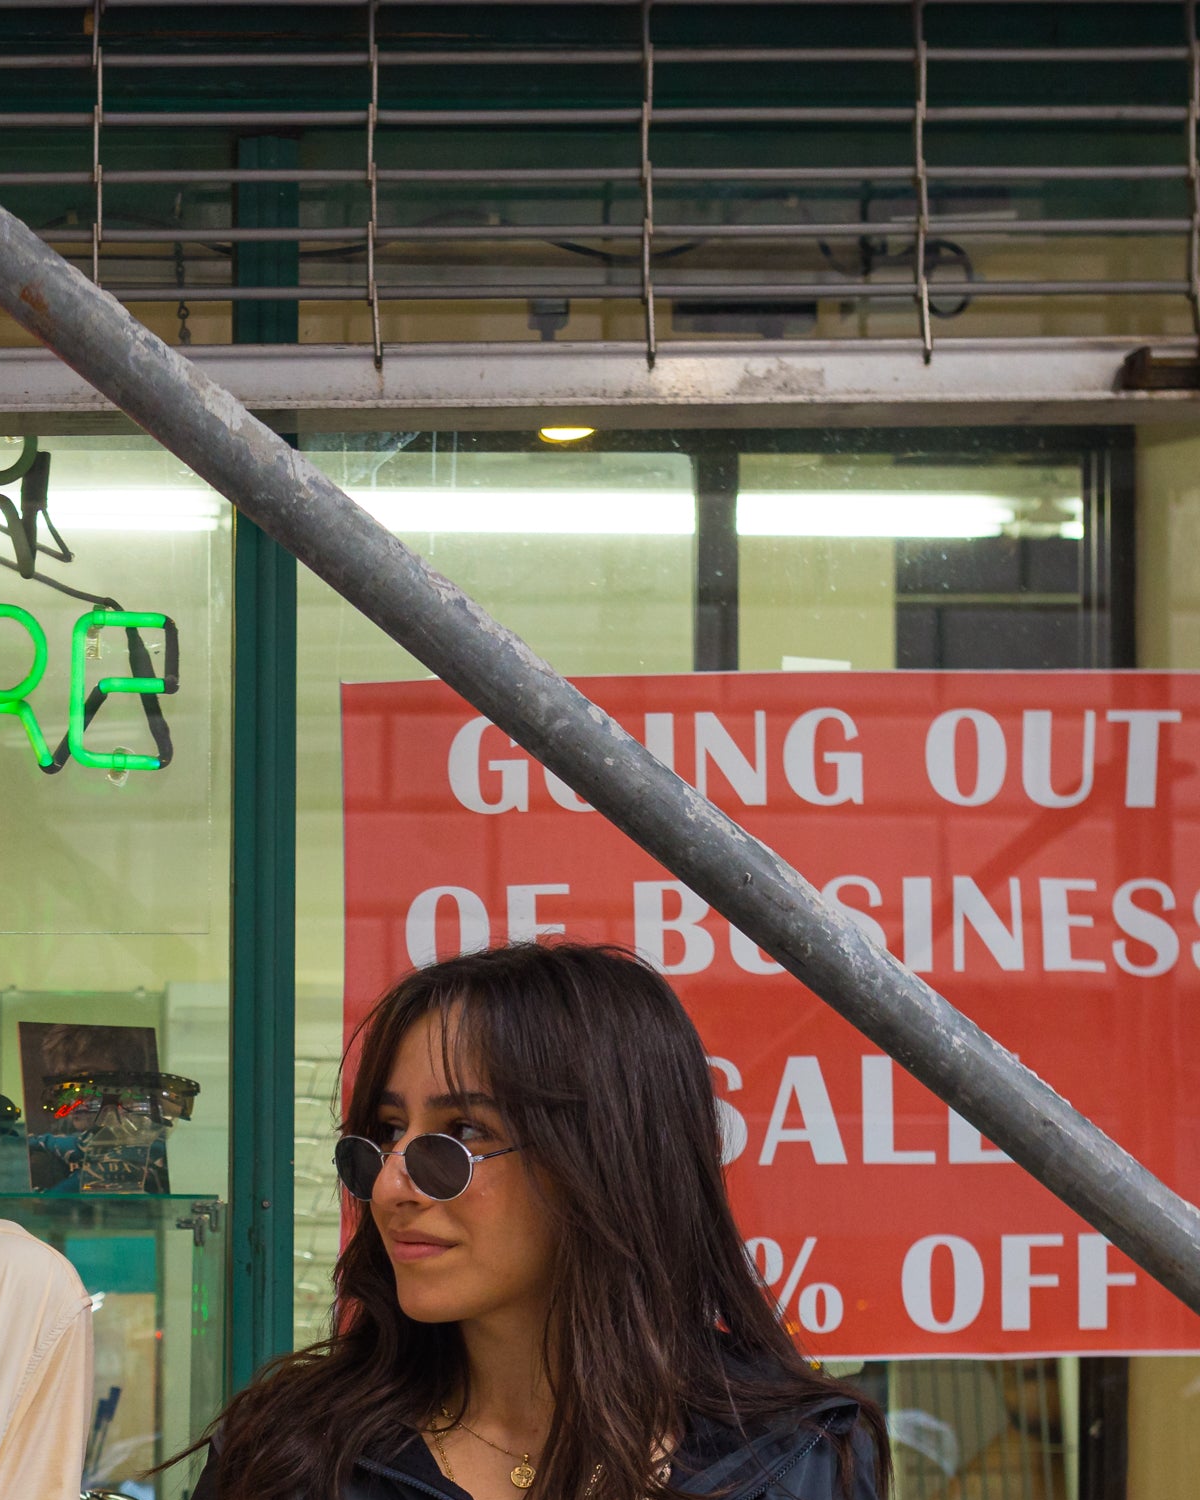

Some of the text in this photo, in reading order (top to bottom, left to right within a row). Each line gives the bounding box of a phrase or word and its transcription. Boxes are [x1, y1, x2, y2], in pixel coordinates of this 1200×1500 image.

[447, 708, 1183, 814] GING OUT
[405, 875, 1200, 977] OF BSINES
[901, 1233, 1137, 1334] OFF
